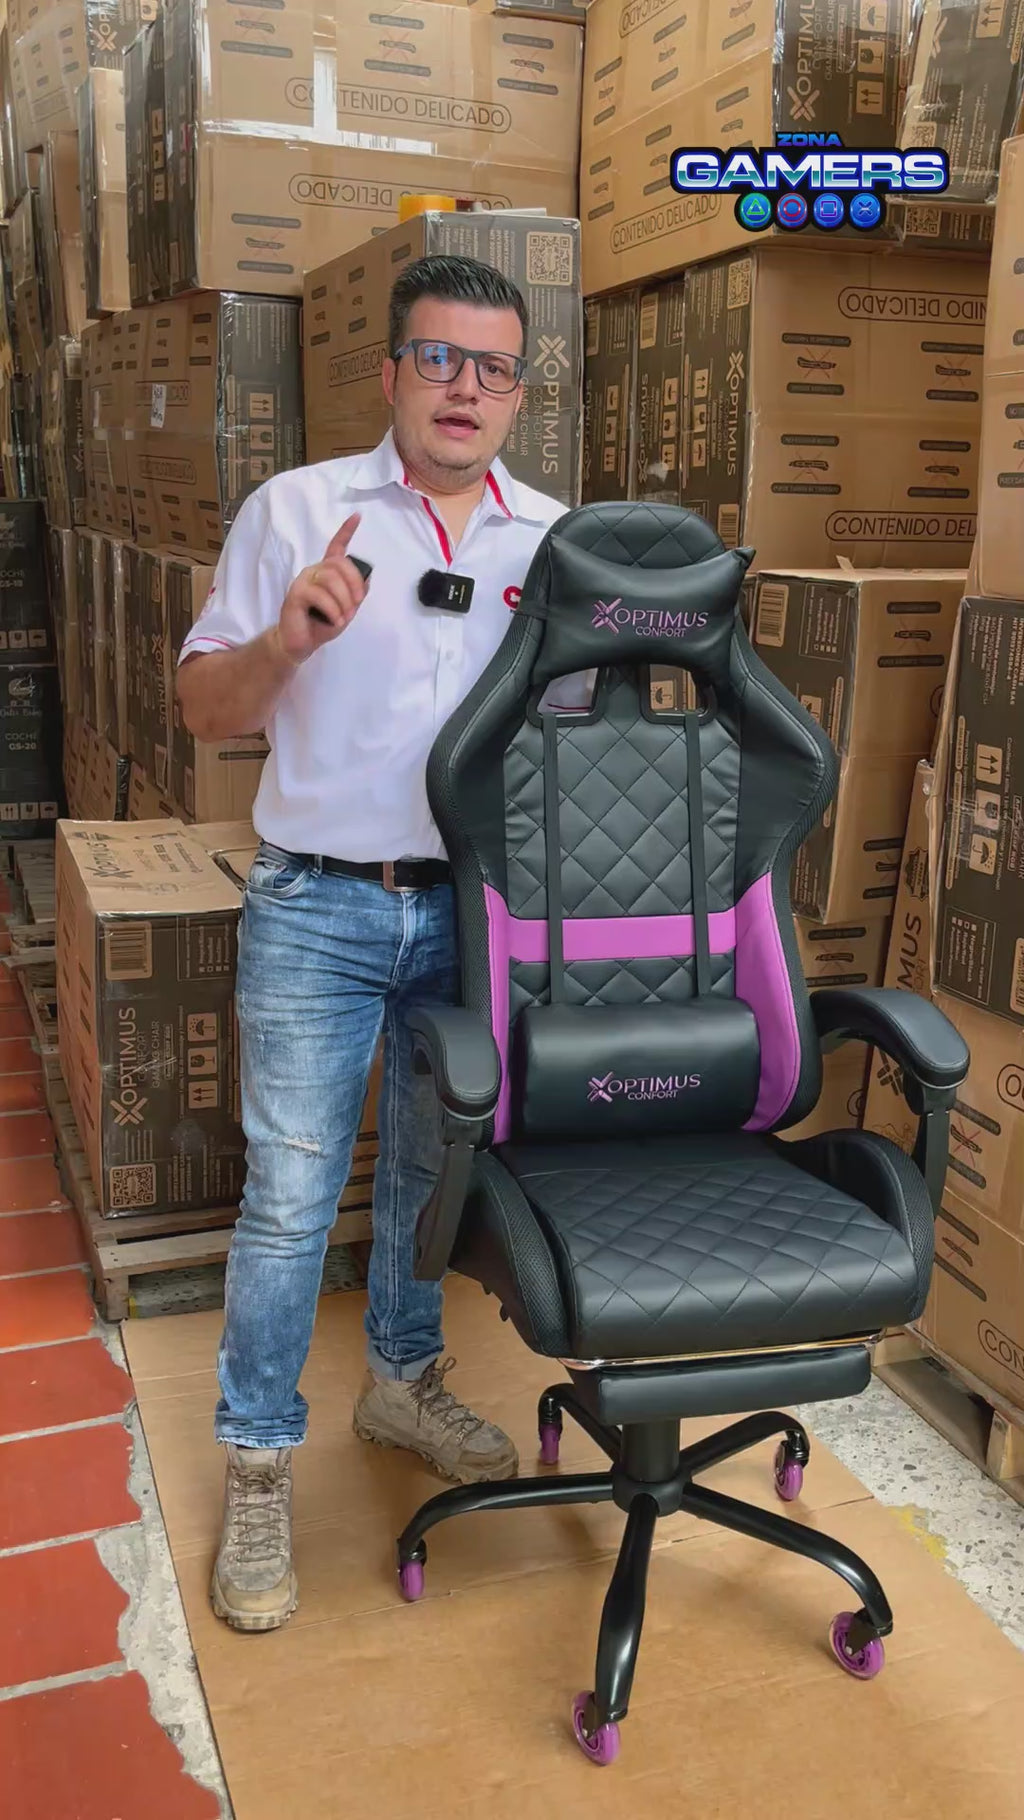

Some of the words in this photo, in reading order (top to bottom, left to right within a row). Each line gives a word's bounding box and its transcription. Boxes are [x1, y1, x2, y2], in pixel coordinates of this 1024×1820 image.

[414, 99, 505, 127] DELICADO
[297, 180, 393, 207] DELICADO
[613, 212, 665, 247] CONTENIDO
[666, 194, 718, 228] DELICADO
[846, 293, 940, 317] DELICADO
[833, 517, 940, 536] CONTENIDO
[635, 626, 686, 637] CONFORT
[150, 1020, 160, 1050] CHAIR
[627, 1089, 678, 1101] CONFORT
